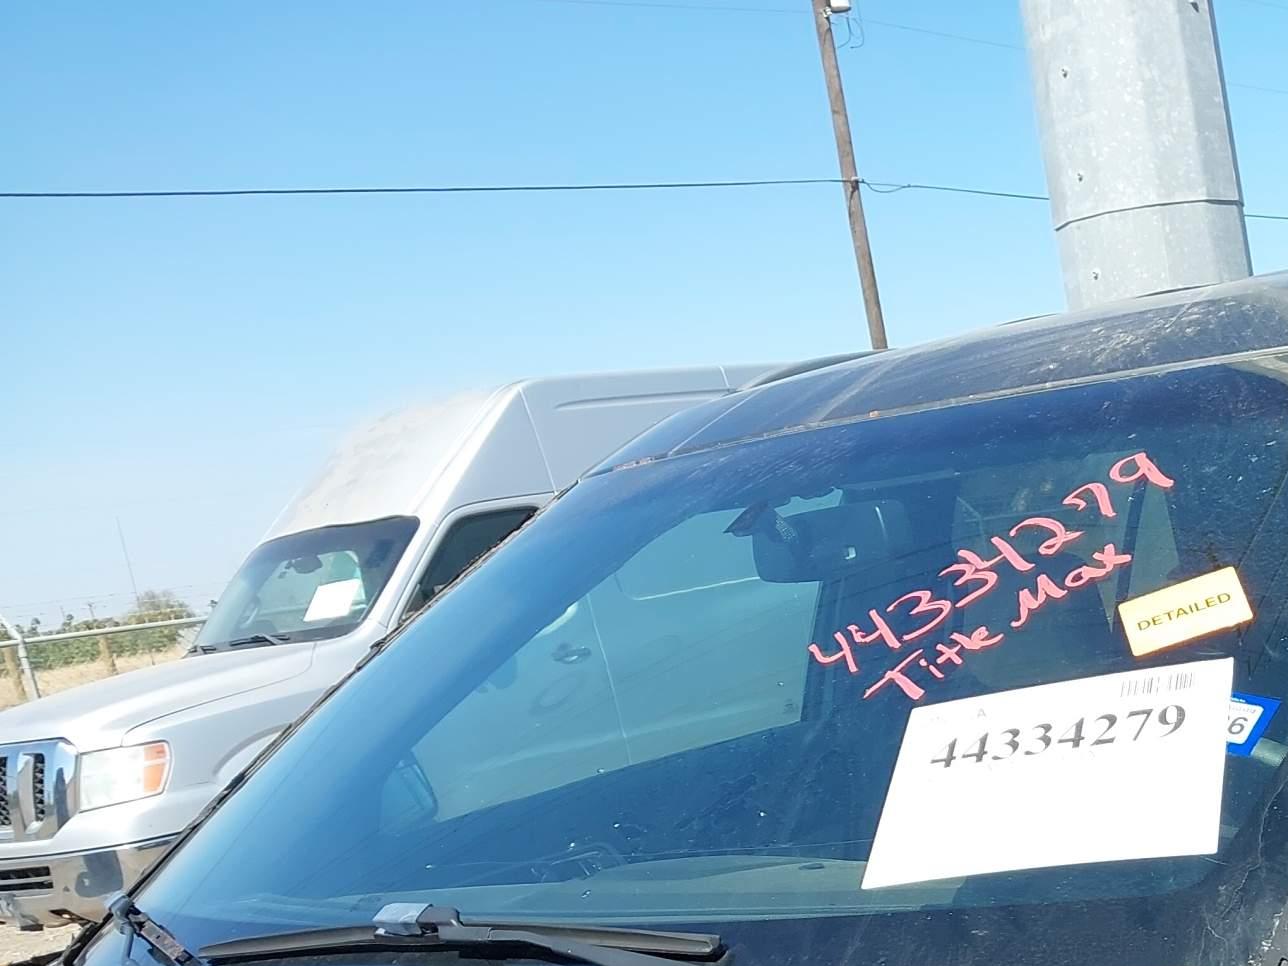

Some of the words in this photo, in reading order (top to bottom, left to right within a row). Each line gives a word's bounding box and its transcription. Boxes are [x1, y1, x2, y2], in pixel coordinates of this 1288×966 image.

[808, 452, 1175, 673] 44334279
[1136, 591, 1234, 632] DETAILED
[863, 626, 1004, 700] Title
[1011, 543, 1132, 627] Max
[929, 703, 1188, 770] 44334279
